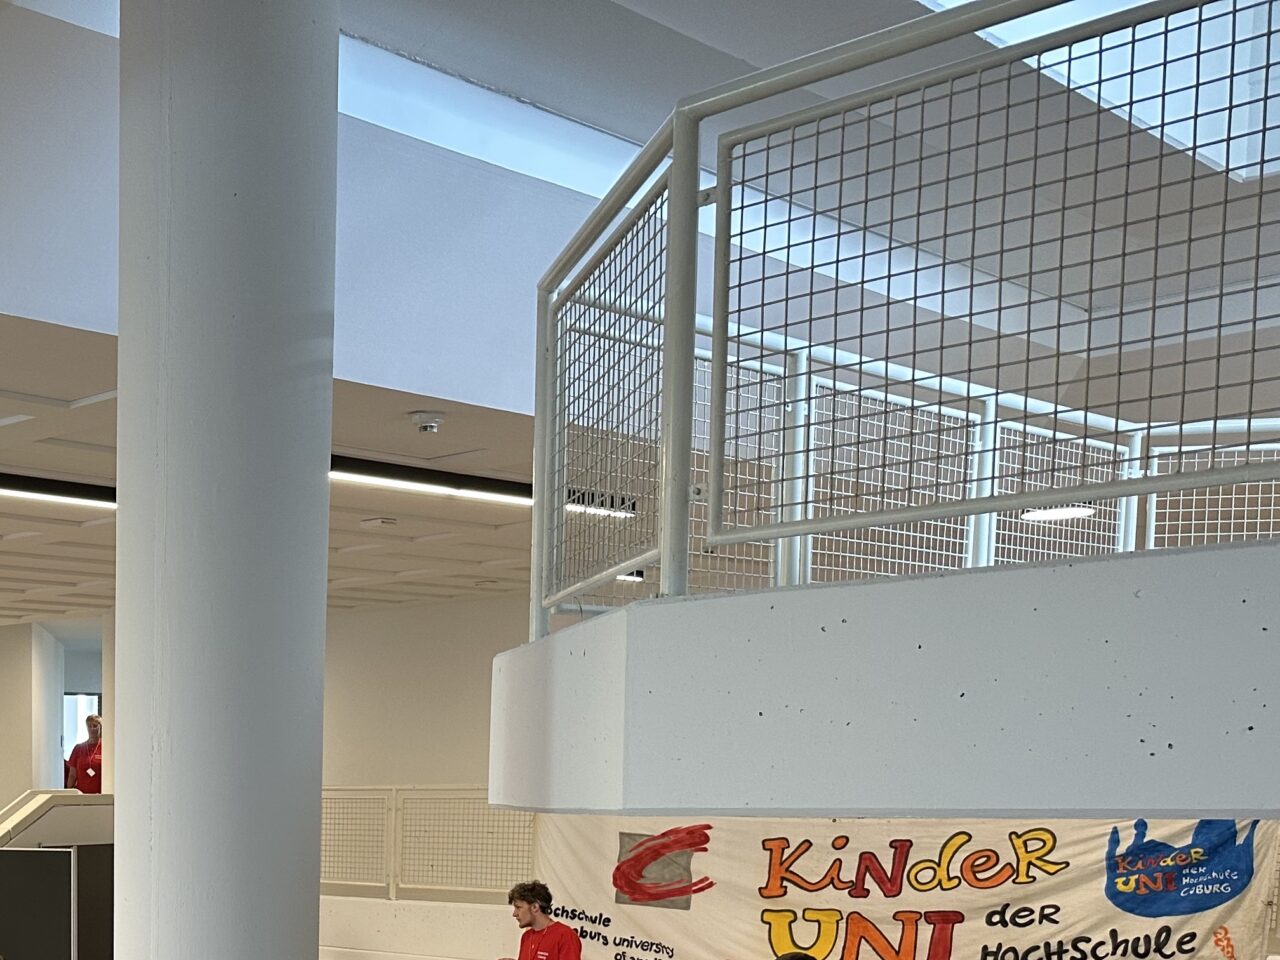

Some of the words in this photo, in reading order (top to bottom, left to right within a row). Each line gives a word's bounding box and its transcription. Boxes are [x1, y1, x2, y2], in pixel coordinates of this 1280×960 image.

[1114, 871, 1178, 896] UNI
[546, 904, 612, 928] ochschule
[613, 935, 675, 959] university
